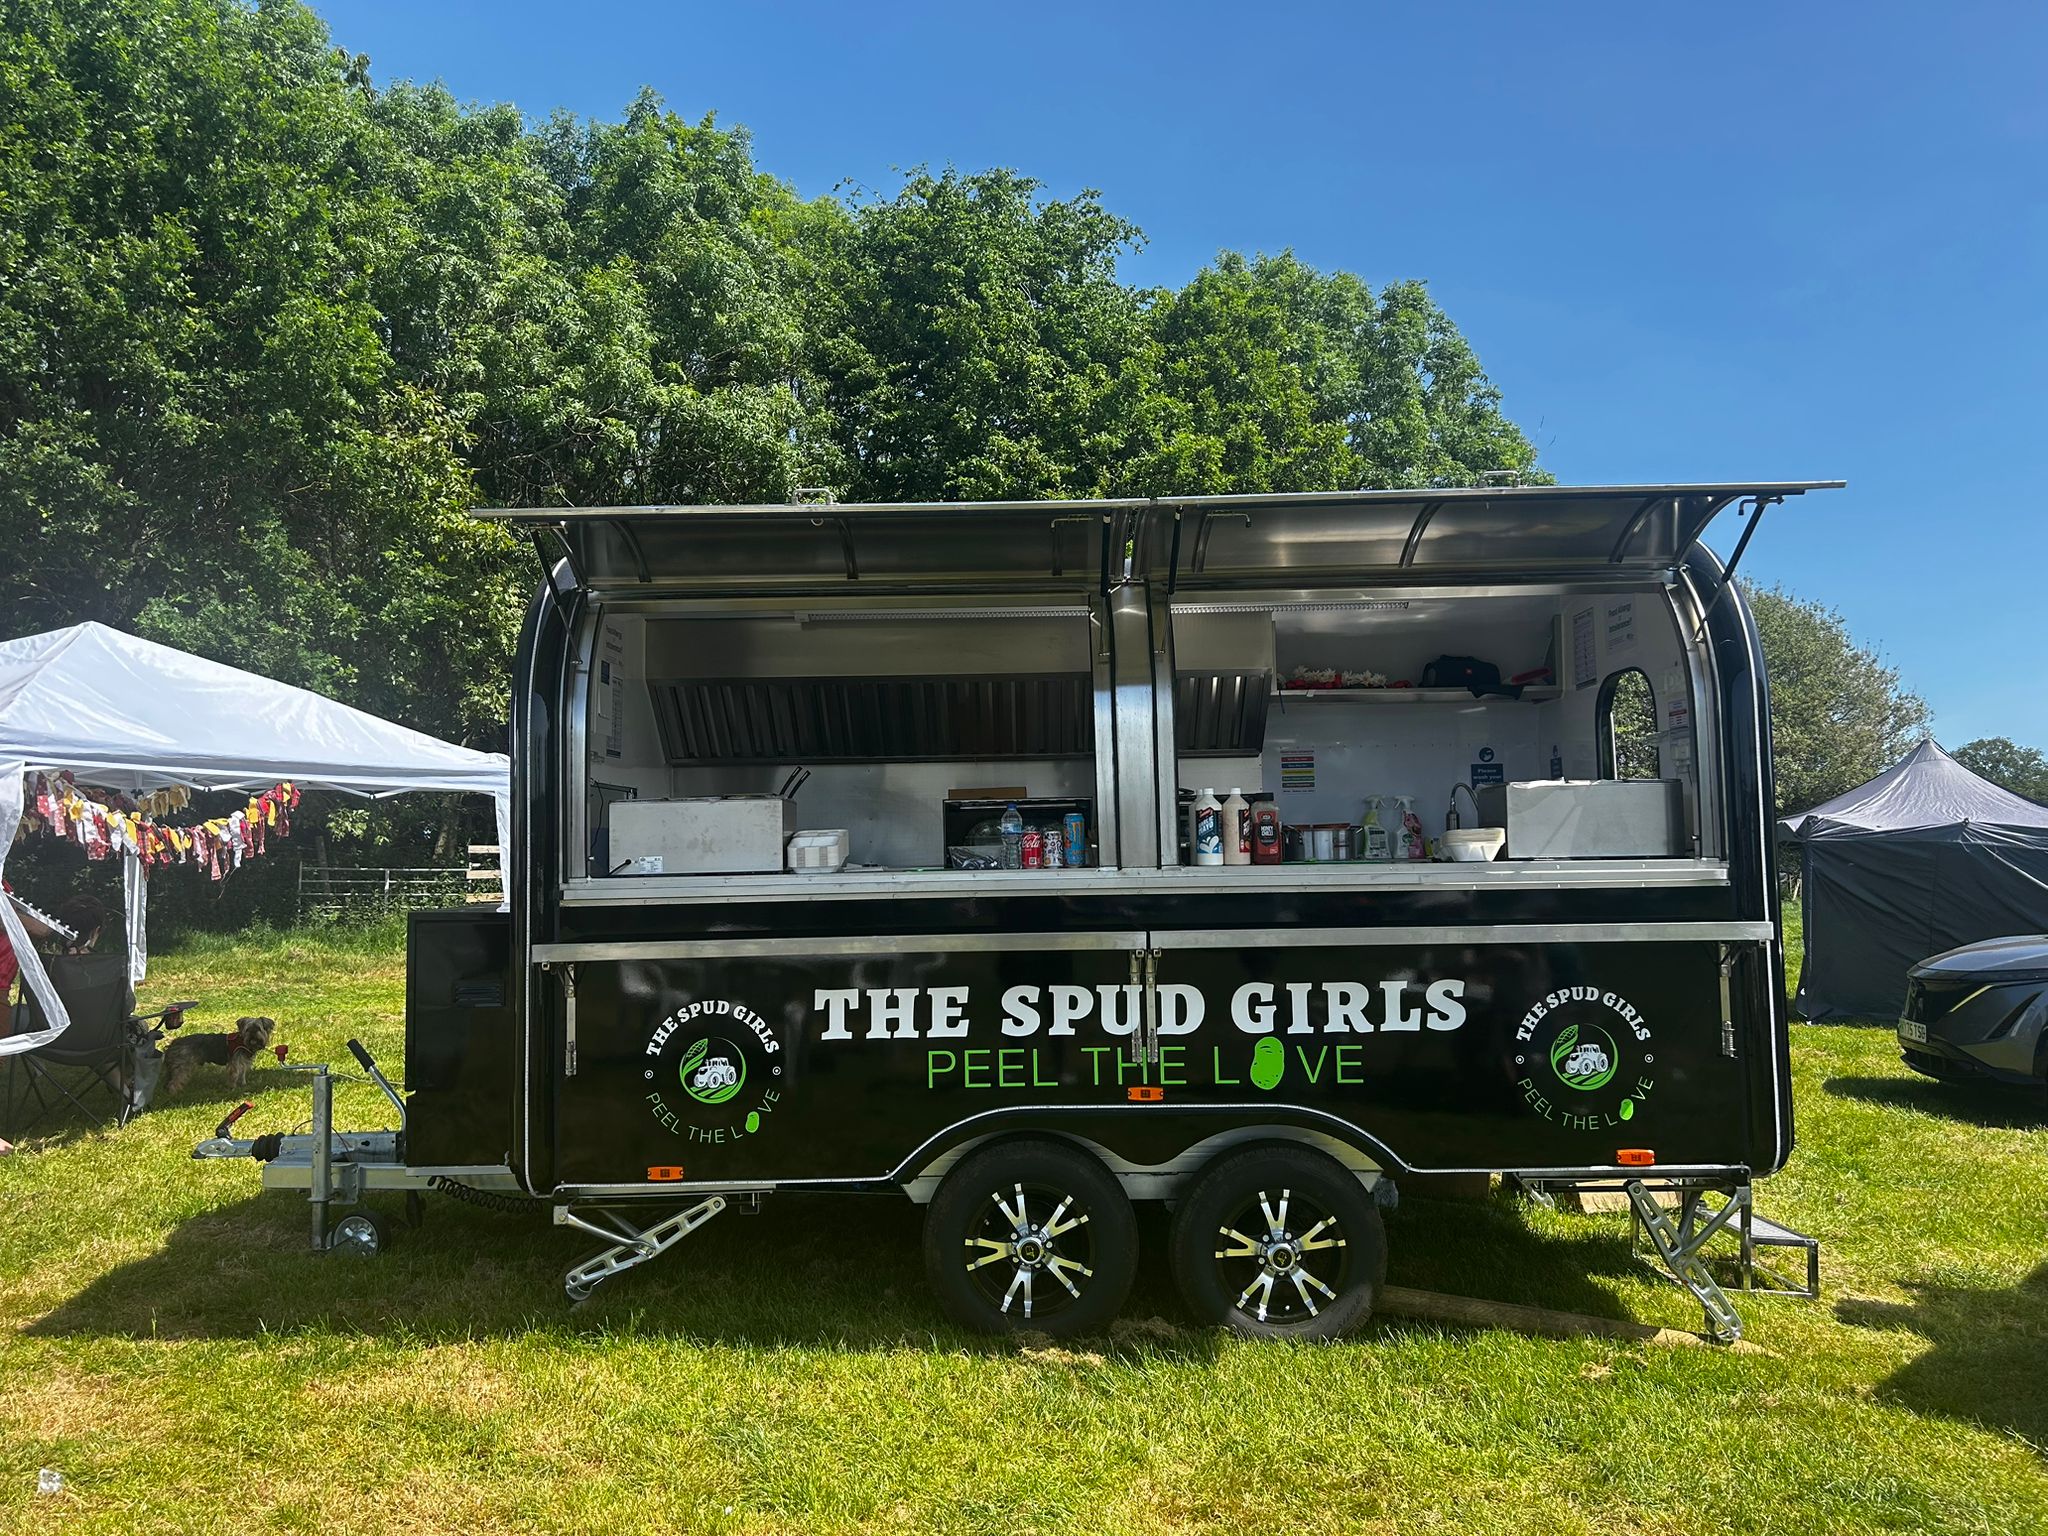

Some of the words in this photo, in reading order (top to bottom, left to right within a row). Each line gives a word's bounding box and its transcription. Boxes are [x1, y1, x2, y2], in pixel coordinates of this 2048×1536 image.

[646, 1016, 679, 1056] THE
[677, 1000, 730, 1023] SPUD
[733, 1005, 780, 1053] GIRLS
[815, 986, 969, 1040] THE
[1001, 984, 1205, 1036] SPUD
[1231, 980, 1466, 1034] GIRLS
[1515, 1001, 1548, 1042] THE
[1546, 986, 1600, 1009] SPUD
[1602, 992, 1652, 1041] GIRLS
[928, 1049, 1058, 1088] PEEL
[1081, 1046, 1187, 1085] THE
[645, 1092, 680, 1135] PEEL
[688, 1125, 726, 1144] THE
[1517, 1077, 1553, 1121] PEEL
[1561, 1111, 1600, 1130] THE
